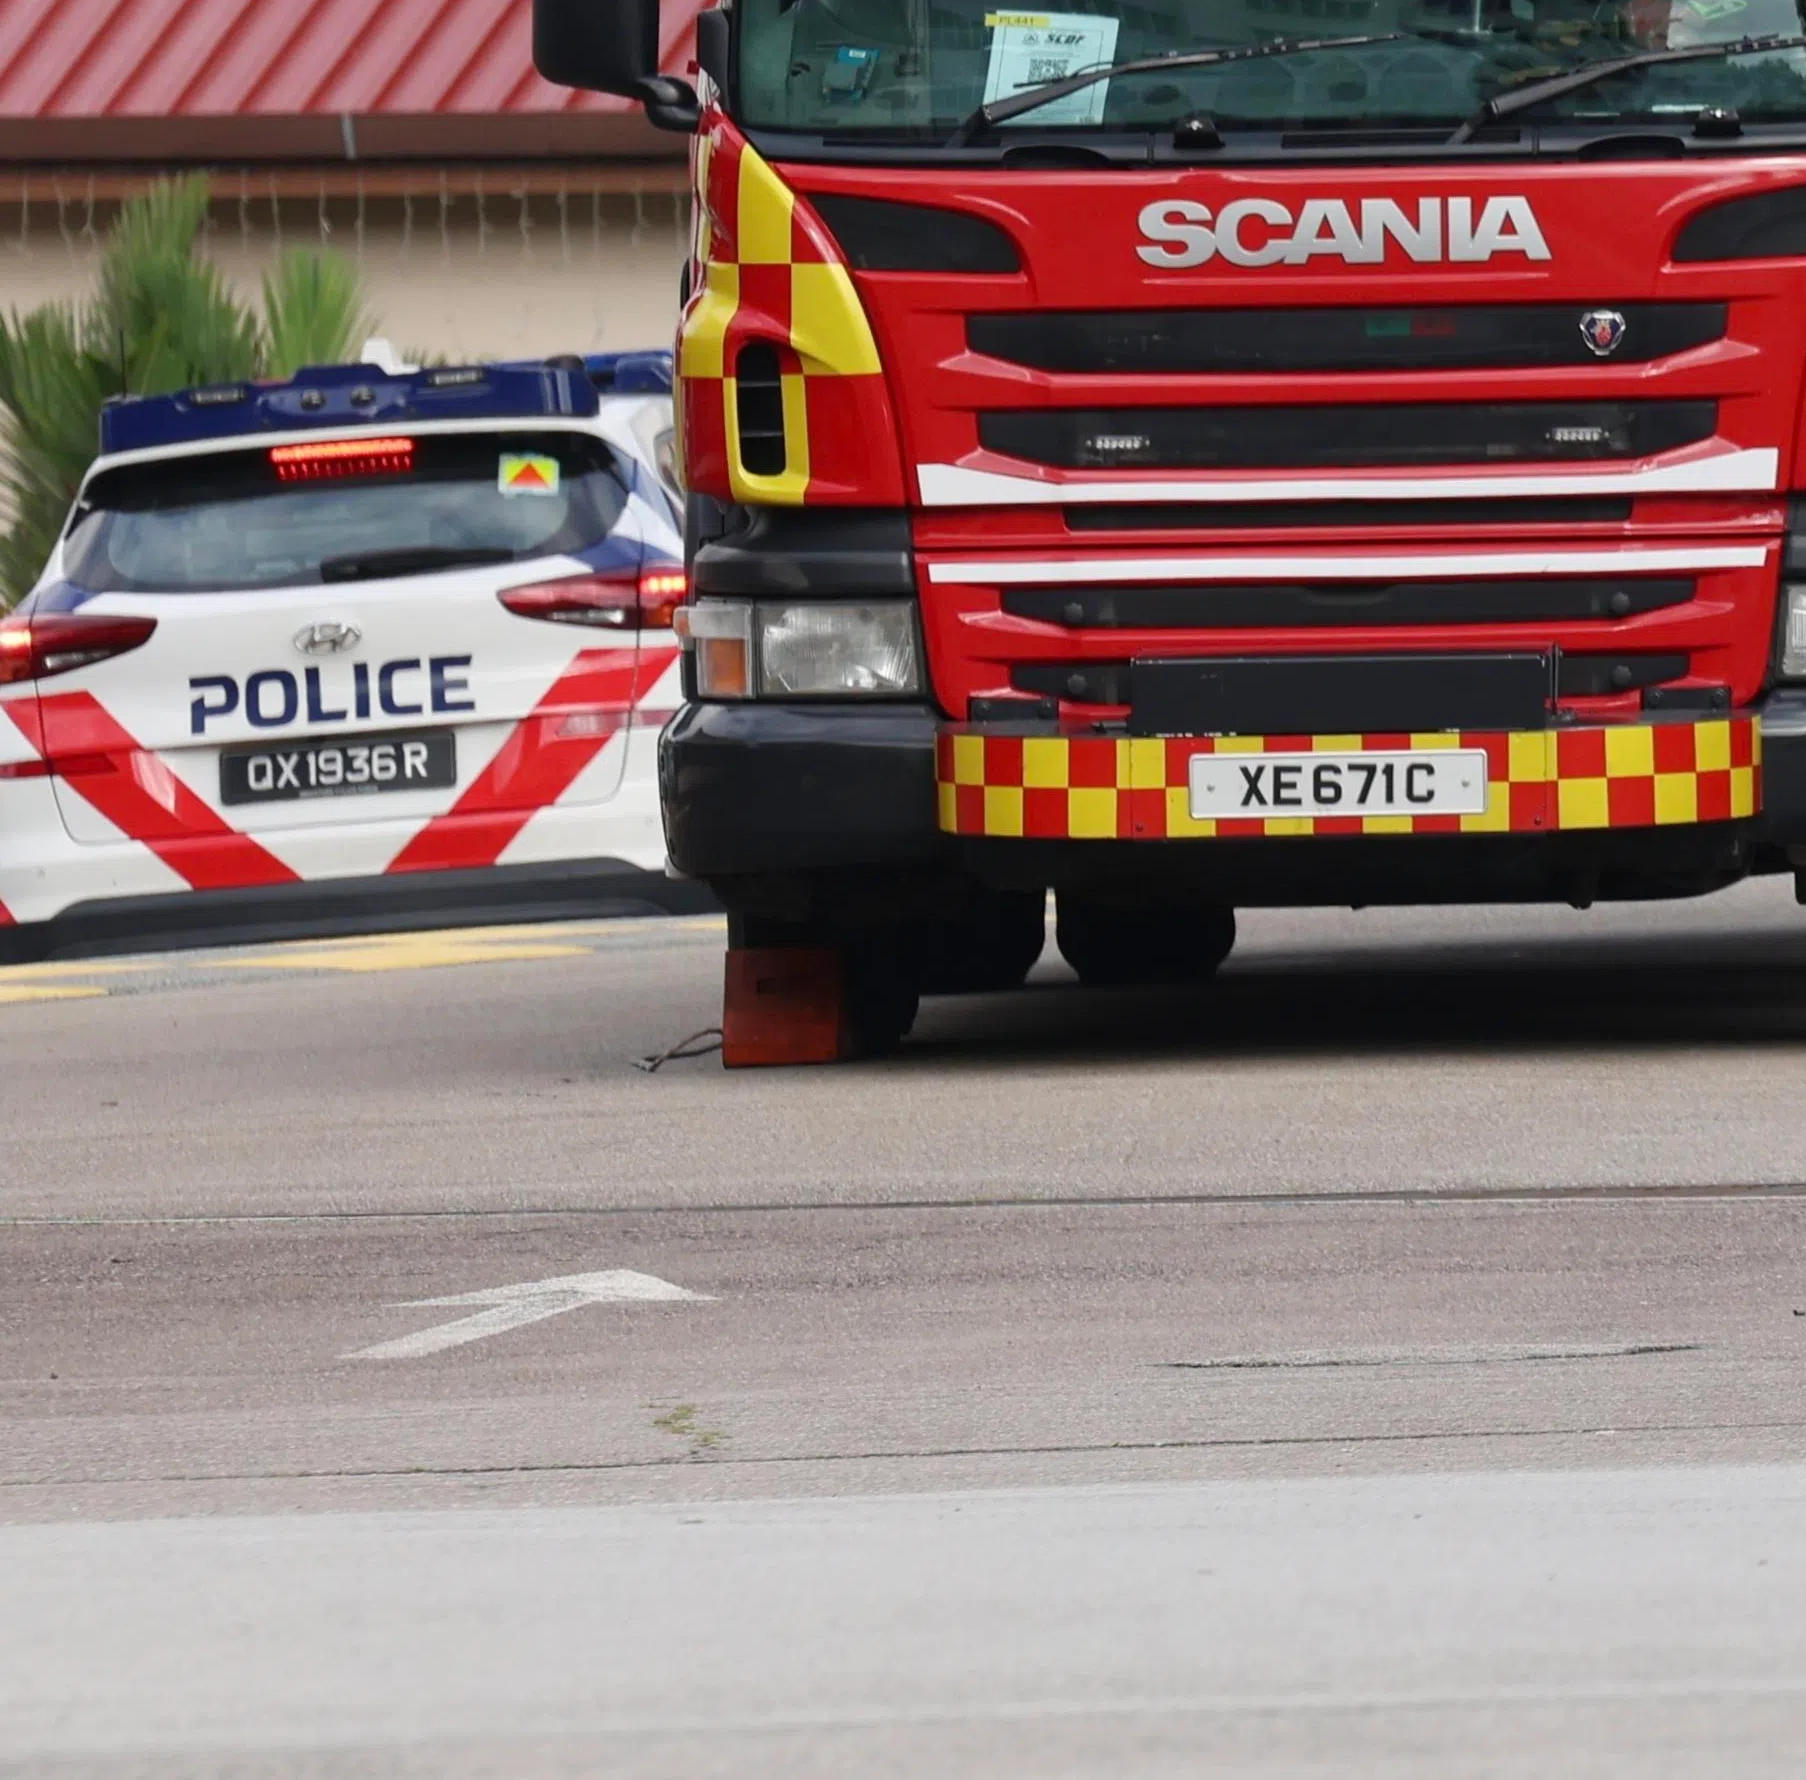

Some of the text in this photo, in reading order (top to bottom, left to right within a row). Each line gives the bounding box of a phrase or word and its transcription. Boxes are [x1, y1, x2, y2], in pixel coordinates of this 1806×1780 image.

[1135, 195, 1553, 268] SCANIA
[189, 654, 476, 734] POLICE
[247, 741, 429, 791] QX1936R
[1239, 762, 1436, 807] XE671C
